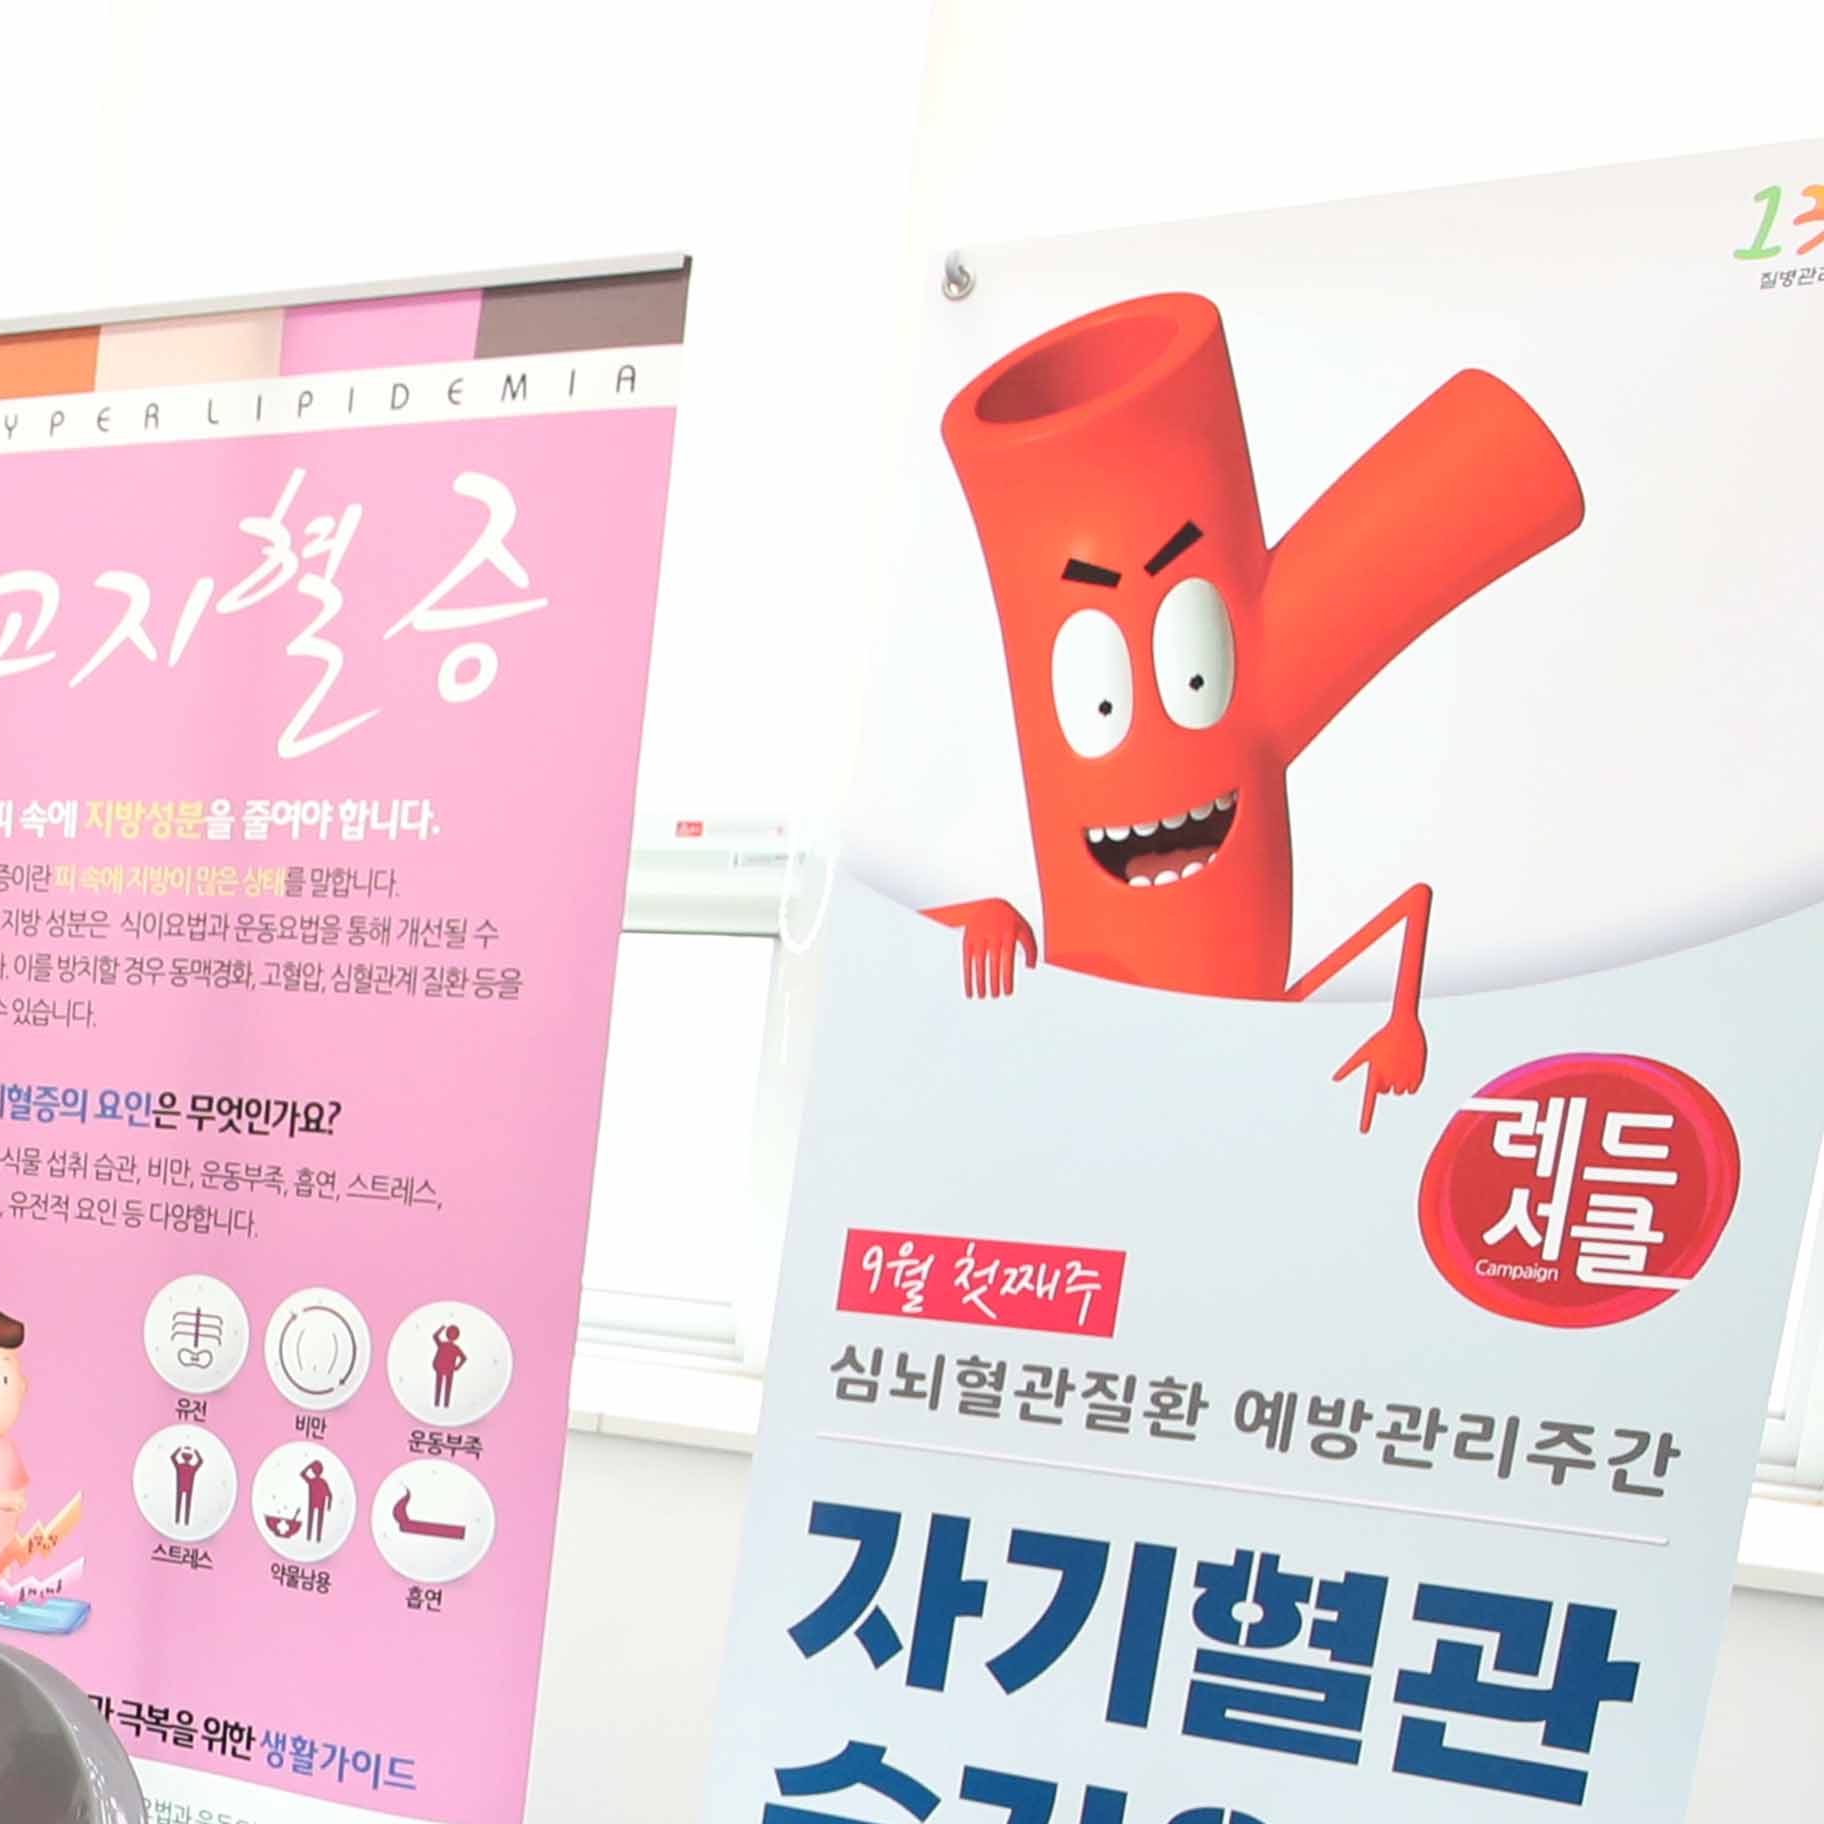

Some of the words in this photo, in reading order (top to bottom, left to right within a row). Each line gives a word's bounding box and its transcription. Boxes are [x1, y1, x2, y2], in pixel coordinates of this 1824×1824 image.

[1760, 266, 1824, 290] 질병관
[20, 800, 79, 839] 속에
[84, 799, 235, 840] 지방성분을
[242, 799, 334, 840] 줄여야
[339, 799, 441, 840] 합니다.
[2, 909, 41, 937] 지방
[46, 910, 110, 939] 성분은
[121, 911, 230, 941] 식이요법과
[234, 913, 342, 946] 운동요법을
[347, 915, 392, 947] 통해
[398, 917, 468, 950] 개선될
[474, 919, 499, 950] 수
[14, 953, 52, 982] 이를
[57, 955, 120, 985] 방치할
[124, 956, 165, 987] 경우
[169, 957, 256, 991] 동맥경화,
[260, 962, 326, 994] 고혈압,
[331, 963, 418, 996] 심혈관계
[423, 966, 469, 998] 질환
[473, 967, 524, 1000] 등을
[94, 1089, 181, 1130] 요인은
[187, 1095, 342, 1138] 무엇인가요?
[1464, 1097, 1678, 1187] 레드
[47, 1150, 88, 1180] 섭취
[94, 1153, 141, 1185] 습관,
[147, 1156, 194, 1189] 비만,
[200, 1159, 288, 1197] 운동부족,
[294, 1167, 341, 1202] 흡연,
[346, 1173, 443, 1211] 스트레스,
[1483, 1181, 1689, 1288] 서클
[861, 1244, 934, 1315] 9월
[953, 1242, 1102, 1326] 첫째주
[1475, 1258, 1559, 1283] Campaign
[175, 1398, 207, 1423] 유전
[295, 1415, 328, 1441] 비만
[829, 1343, 1209, 1442] 심뇌혈관질환
[1233, 1386, 1680, 1499] 예방관리주간
[408, 1431, 483, 1461] 운동부족
[151, 1544, 213, 1570] 스트레스
[271, 1562, 332, 1595] 약물남용
[406, 1586, 443, 1613] 흡연
[787, 1501, 1640, 1806] 자기혈관
[117, 1699, 197, 1749] 극복을
[202, 1716, 256, 1761] 위한
[260, 1728, 417, 1790] 생활가이드
